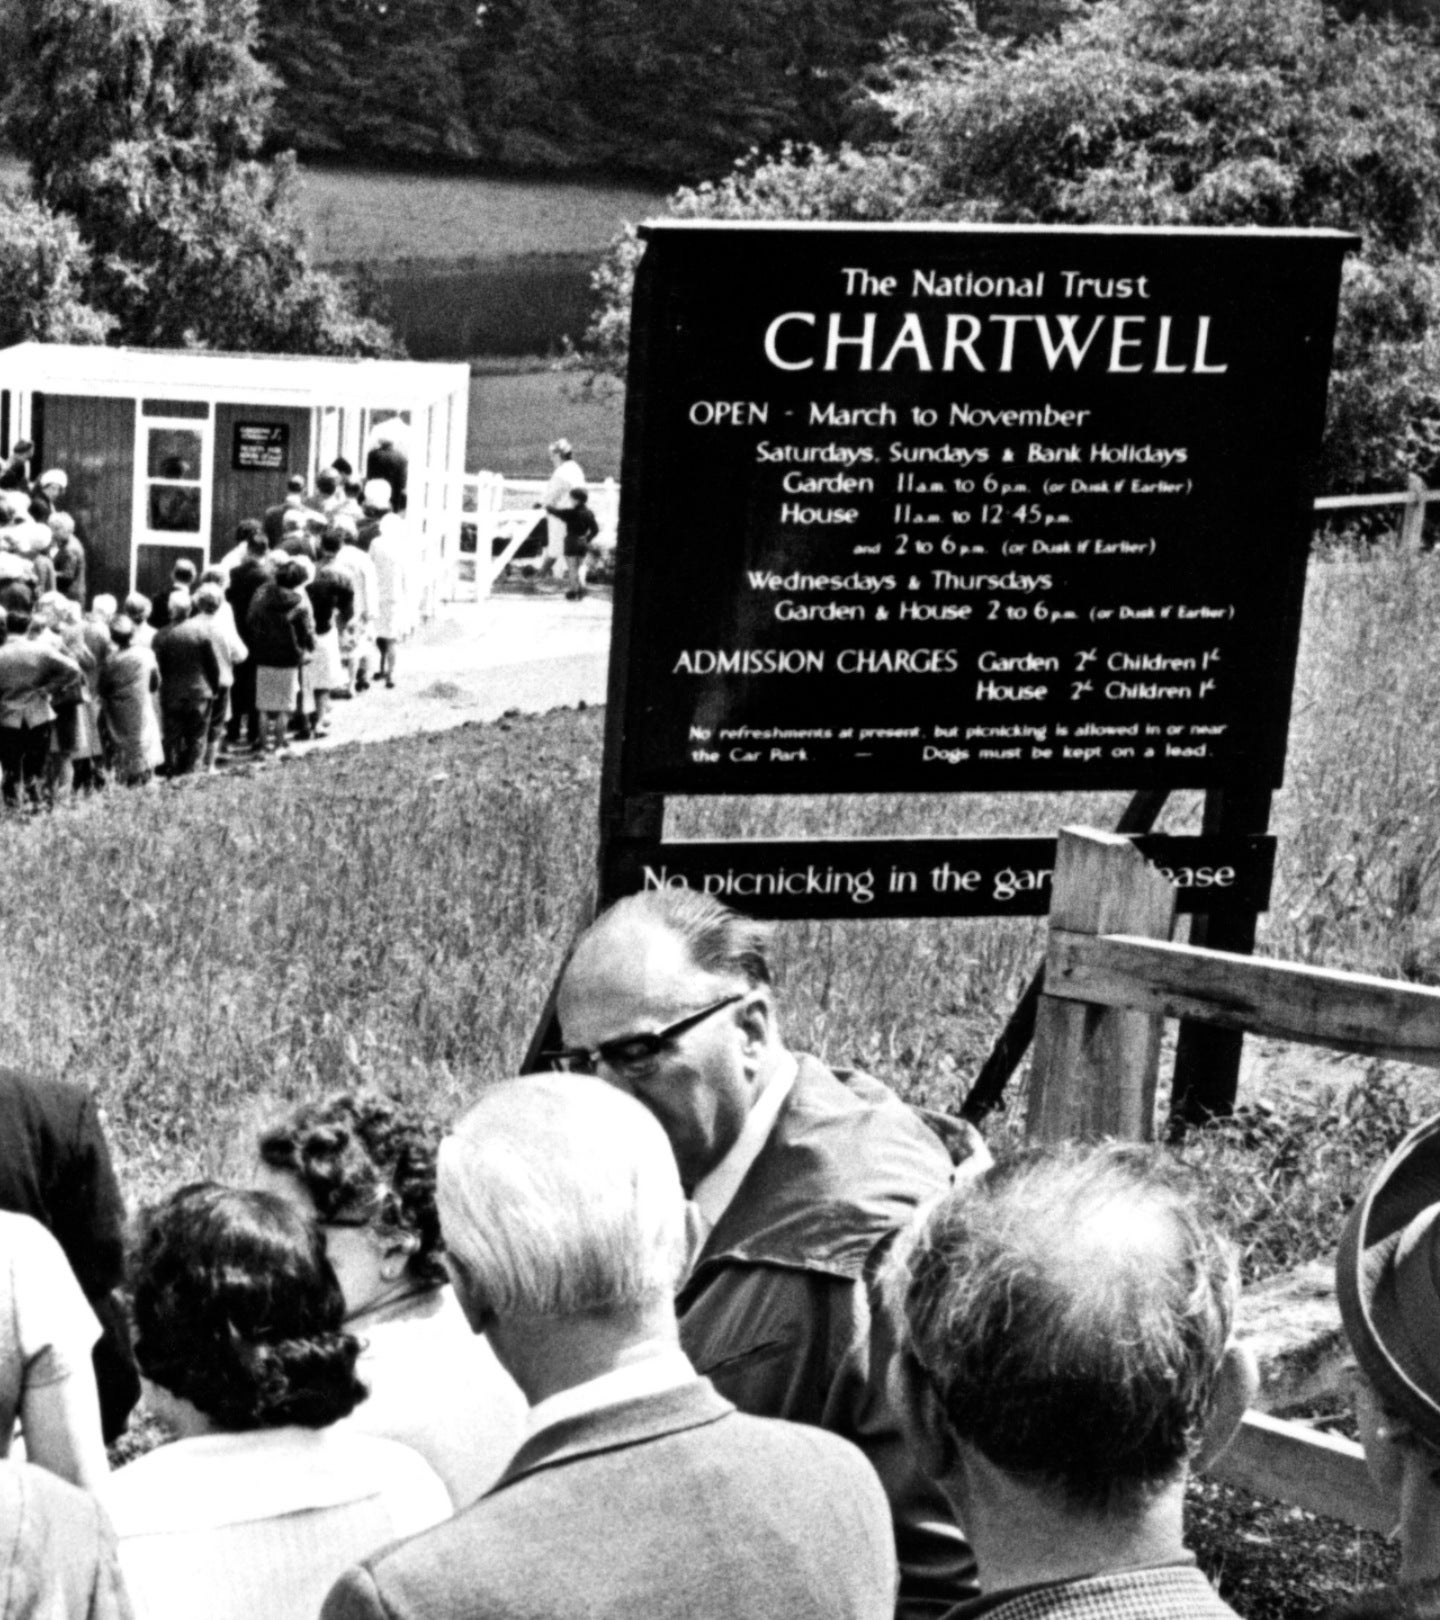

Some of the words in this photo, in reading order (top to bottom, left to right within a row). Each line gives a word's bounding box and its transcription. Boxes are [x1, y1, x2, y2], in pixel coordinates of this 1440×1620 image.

[842, 268, 897, 297] The
[912, 269, 1045, 298] National
[1061, 270, 1150, 299] Trust
[763, 311, 1228, 374] CHARTWELL
[688, 401, 769, 426] OPEN
[809, 401, 897, 427] March
[911, 405, 938, 427] to
[949, 403, 1091, 427] November
[889, 442, 990, 468] Sundays
[1001, 447, 1015, 463] &
[1027, 443, 1081, 463] Bank
[1089, 443, 1189, 468] Holidays
[782, 471, 875, 494] Garden
[954, 478, 976, 493] to
[1042, 479, 1066, 495] (or
[1070, 478, 1110, 494] Dusk
[780, 503, 860, 525] House
[951, 510, 972, 524] to
[853, 542, 882, 555] and
[895, 533, 909, 556] 2
[915, 540, 934, 555] to
[1001, 541, 1027, 556] (or
[1031, 539, 1072, 555] Dusk
[746, 569, 897, 594] Wednesdays
[907, 575, 921, 591] &
[931, 569, 1053, 594] Thursdays
[773, 600, 866, 622] Garden
[874, 604, 890, 622] &
[899, 600, 973, 622] House
[987, 599, 1001, 621] 2
[1006, 605, 1028, 621] to
[1089, 606, 1114, 622] (or
[1118, 605, 1156, 620] Dusk
[672, 648, 825, 675] ADMISSION
[836, 648, 959, 674] CHARGES
[977, 650, 1060, 673] Garden
[1106, 651, 1197, 672] Children
[975, 679, 1049, 702] House
[1104, 680, 1192, 700] Children
[689, 725, 711, 741] No
[719, 725, 833, 740] refreshments
[839, 727, 854, 739] at
[933, 725, 959, 738] but
[965, 724, 1048, 742] picnicking
[1055, 723, 1069, 737] is
[1073, 723, 1140, 737] allowed
[1144, 723, 1162, 736] in
[1165, 725, 1185, 736] or
[1189, 724, 1228, 736] near
[691, 747, 721, 763] the
[728, 747, 761, 763] Car
[922, 746, 971, 765] Dogs
[978, 748, 1022, 760] must
[1031, 746, 1054, 760] be
[1062, 745, 1102, 762] kept
[1110, 746, 1136, 759] on
[1143, 747, 1156, 759] a
[643, 864, 689, 890] No
[704, 865, 875, 904] picnicking
[889, 865, 918, 892] in
[931, 862, 981, 891] the
